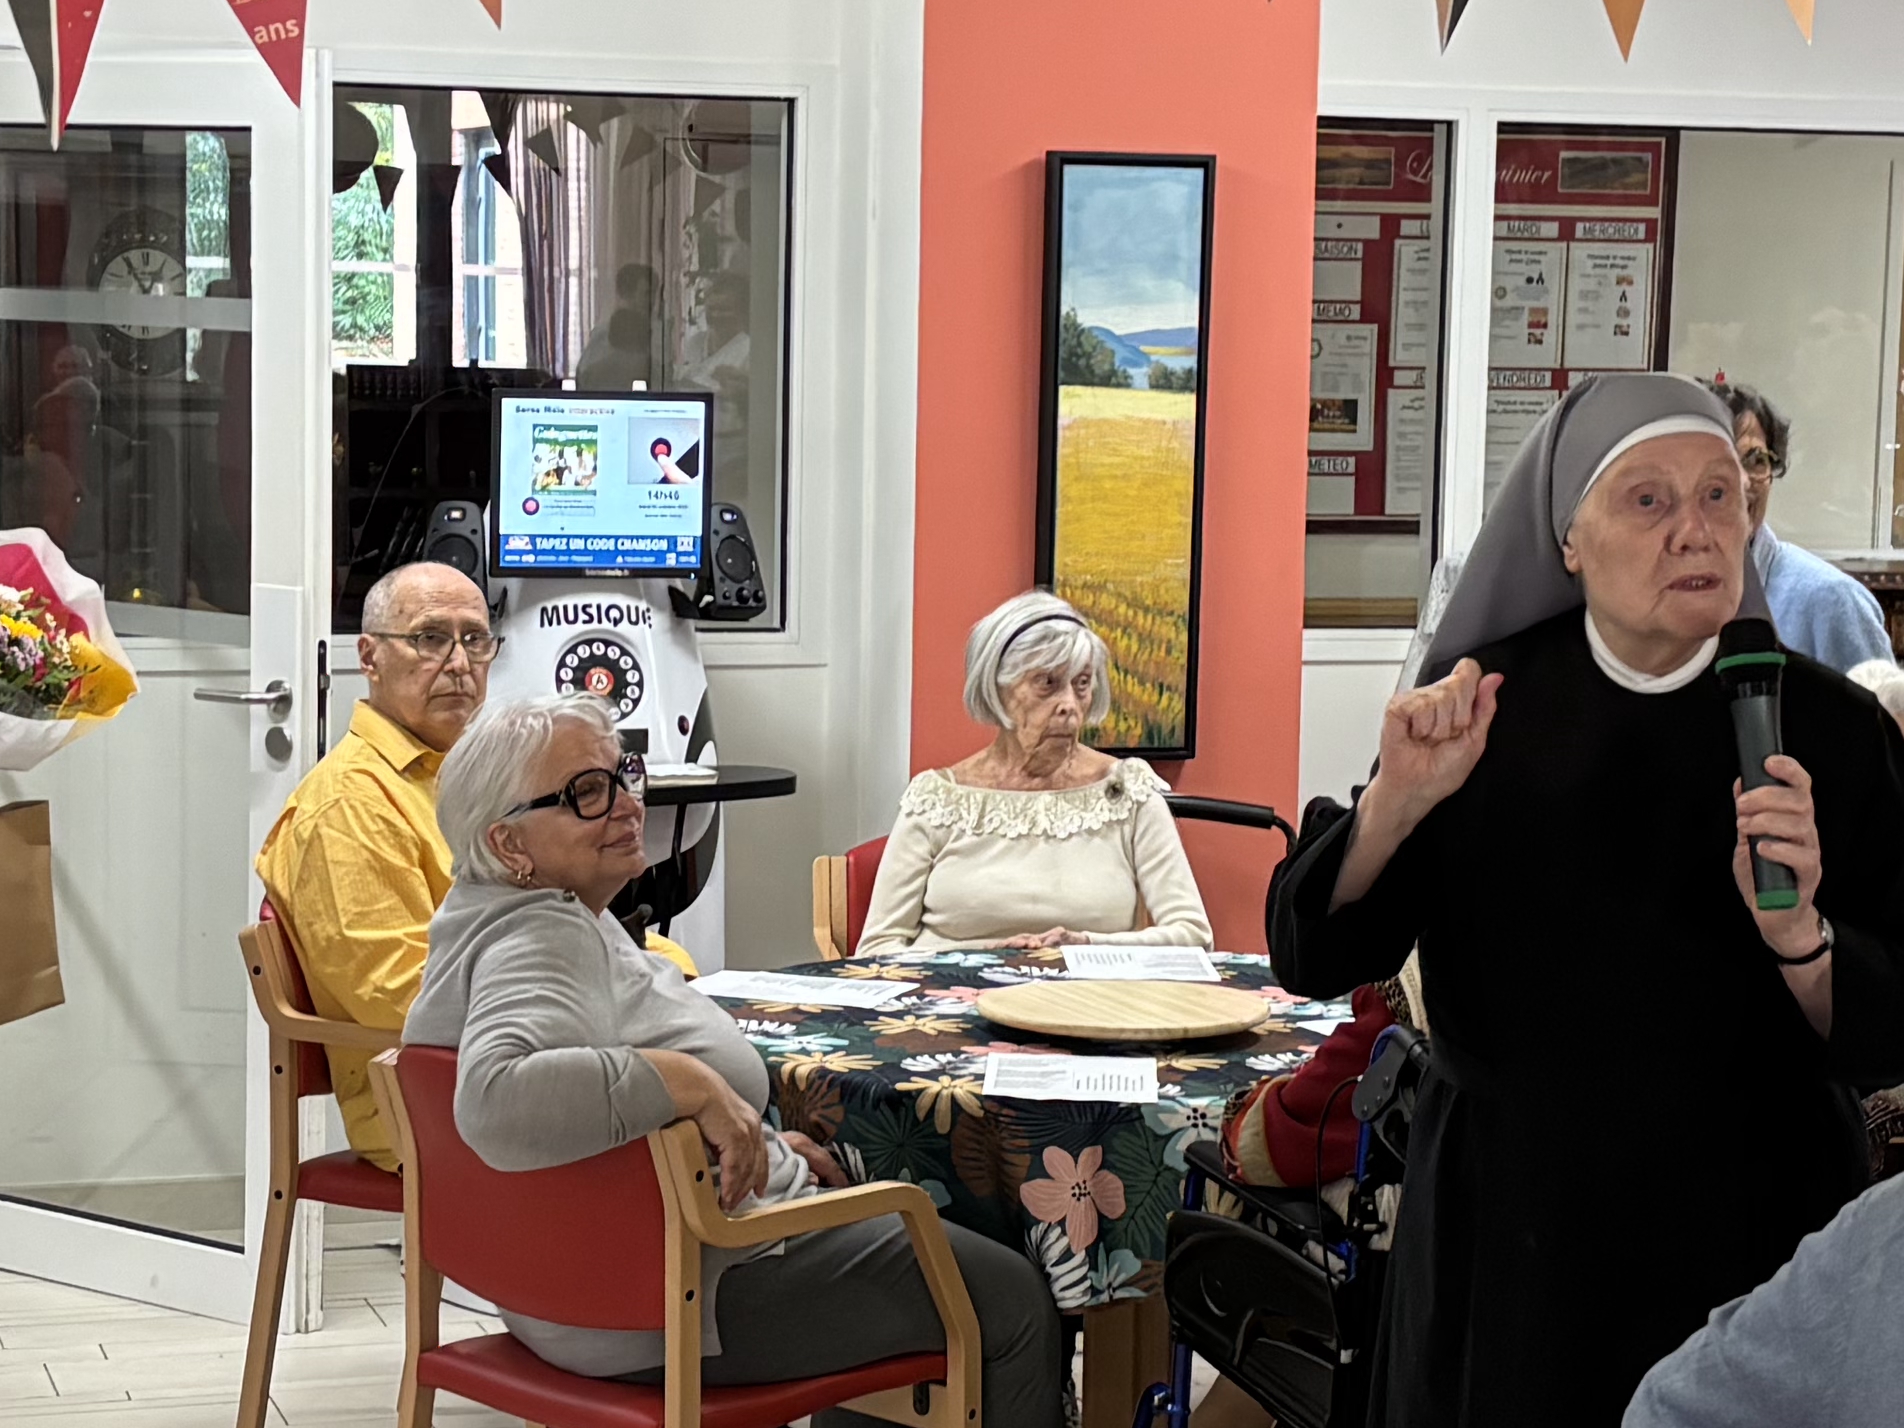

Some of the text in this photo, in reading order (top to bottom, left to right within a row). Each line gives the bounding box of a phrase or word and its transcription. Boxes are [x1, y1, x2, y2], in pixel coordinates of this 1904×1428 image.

[253, 18, 300, 45] ans
[1507, 221, 1541, 236] MARDI
[1582, 223, 1639, 238] MERCREDI
[535, 538, 568, 551] TAPEZ
[569, 538, 585, 551] UN
[586, 538, 616, 551] CODE
[617, 538, 669, 552] CHANSON
[539, 603, 653, 629] MUSIQUE
